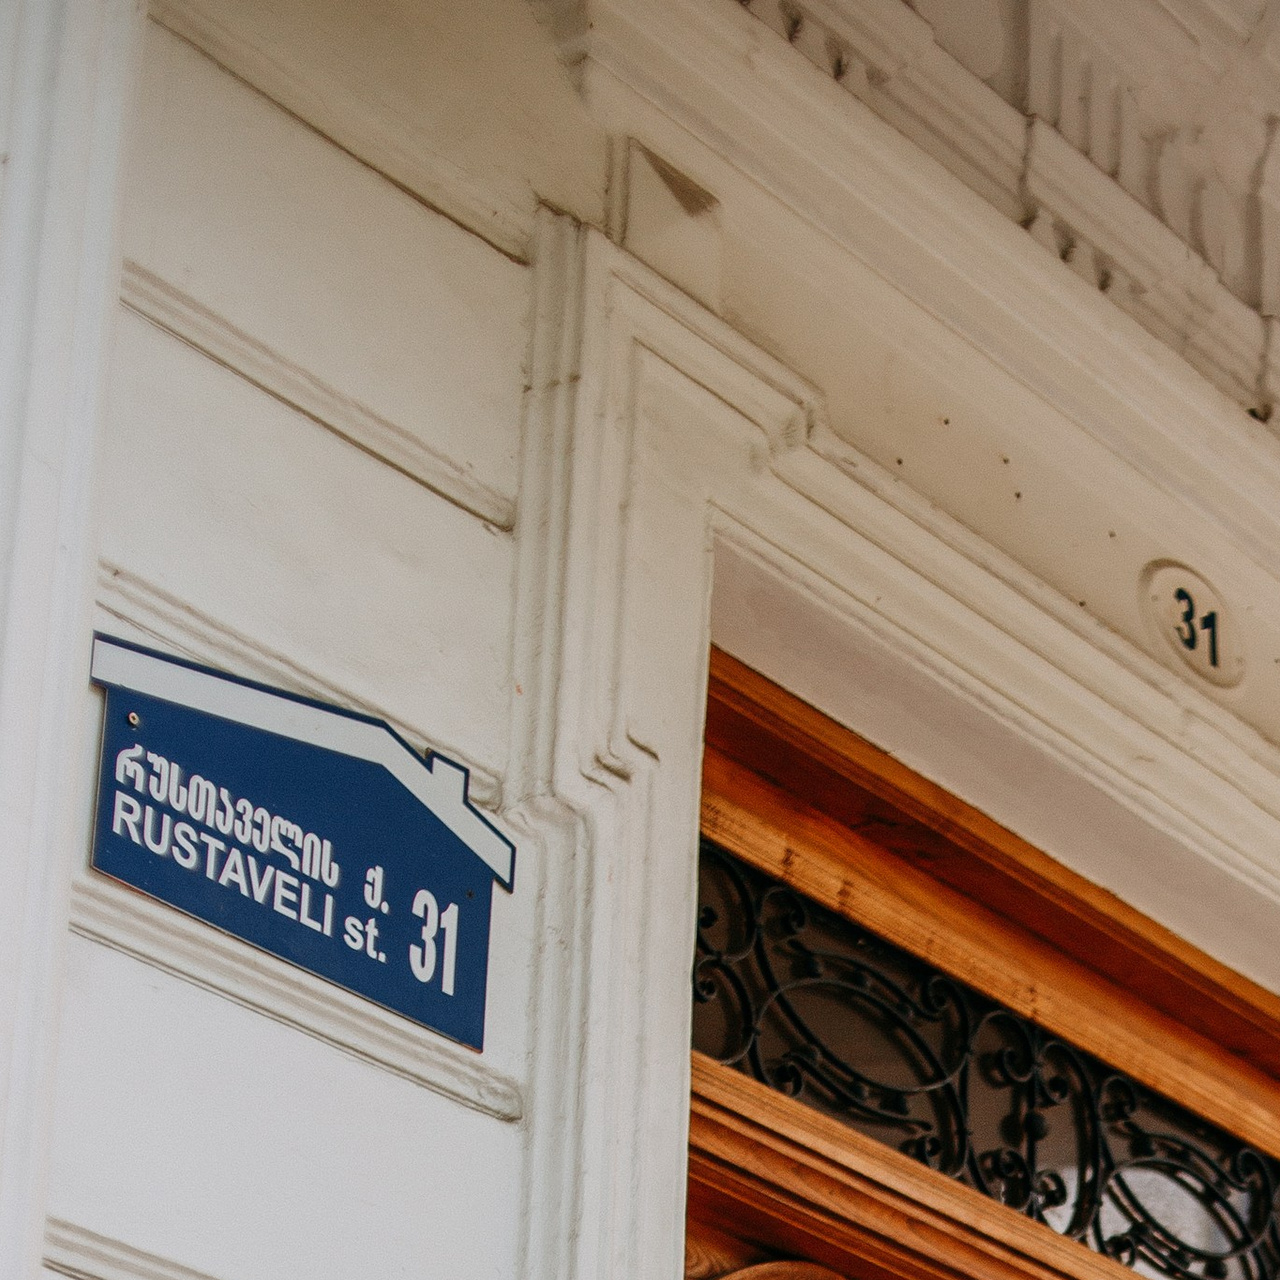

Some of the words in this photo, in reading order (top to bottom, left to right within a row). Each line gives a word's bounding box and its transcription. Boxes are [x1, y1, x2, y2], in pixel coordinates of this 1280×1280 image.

[1174, 587, 1217, 667] 31
[112, 790, 334, 937] RUSTAVELI
[343, 916, 386, 963] st.
[115, 743, 340, 888] რუსთაველის
[409, 889, 459, 996] 31
